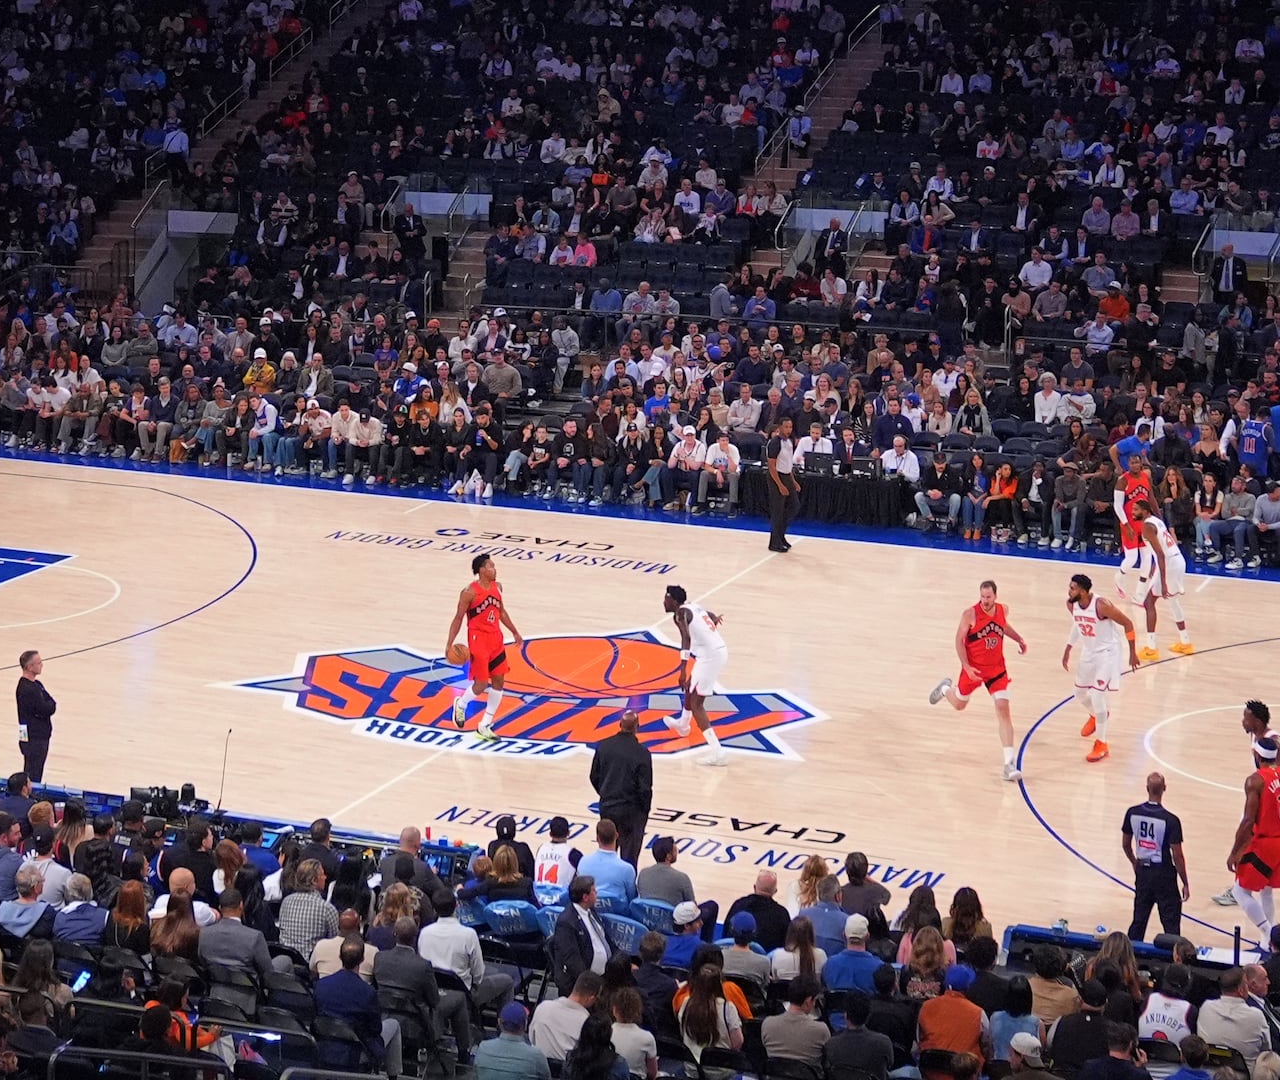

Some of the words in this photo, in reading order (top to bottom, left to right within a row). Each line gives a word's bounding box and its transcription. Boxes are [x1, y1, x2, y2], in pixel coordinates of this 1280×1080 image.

[1243, 437, 1256, 454] 11
[324, 529, 435, 550] GARDEN
[474, 531, 614, 551] CHASE
[439, 540, 542, 561] SQUARE
[547, 553, 677, 575] MADISON
[487, 610, 496, 623] 4
[1078, 623, 1096, 638] 32
[985, 638, 998, 650] 19
[646, 807, 847, 845] CHASE
[1140, 821, 1155, 841] 94
[537, 863, 560, 884] 14
[498, 901, 521, 917] TEN
[610, 920, 636, 936] TEN
[1146, 1012, 1184, 1032] ANUNOBY
